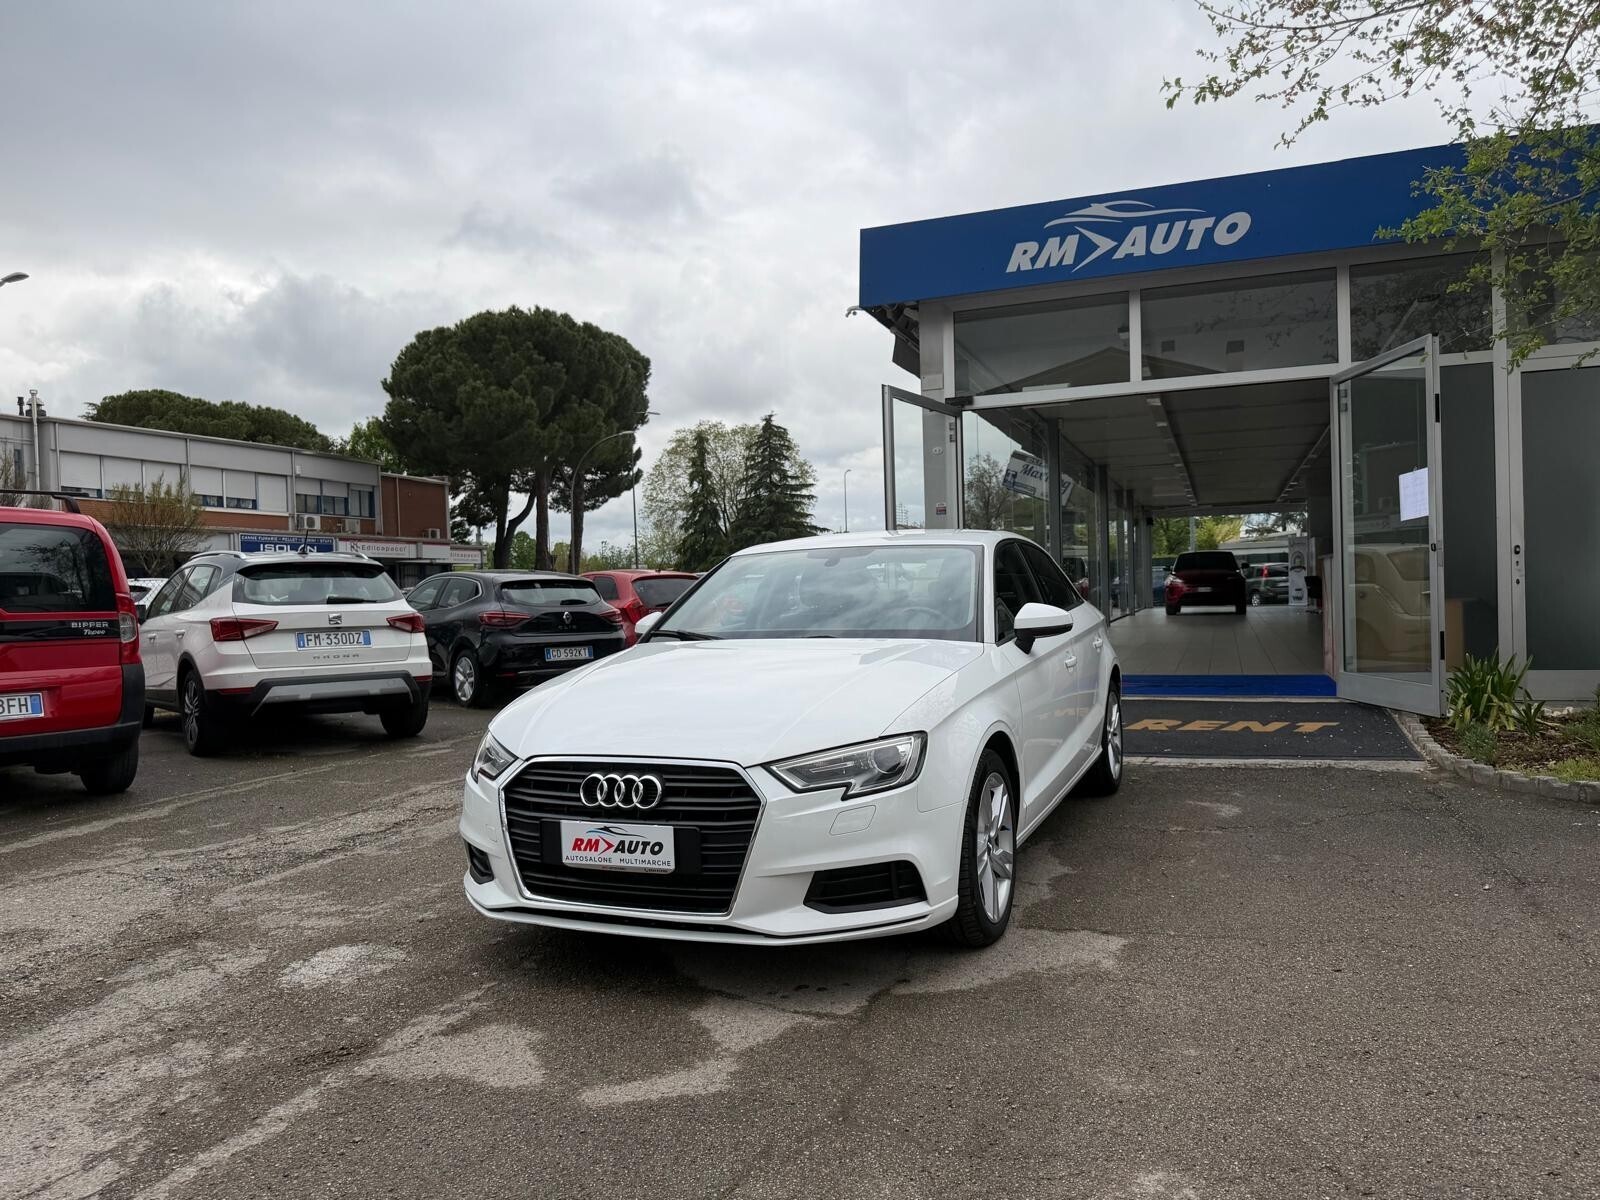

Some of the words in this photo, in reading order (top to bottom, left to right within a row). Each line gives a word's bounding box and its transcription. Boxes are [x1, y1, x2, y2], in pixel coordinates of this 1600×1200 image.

[1123, 718, 1340, 733] RENT
[565, 855, 612, 863] AUTOSALONE
[620, 858, 671, 867] MULTIMARCHE
